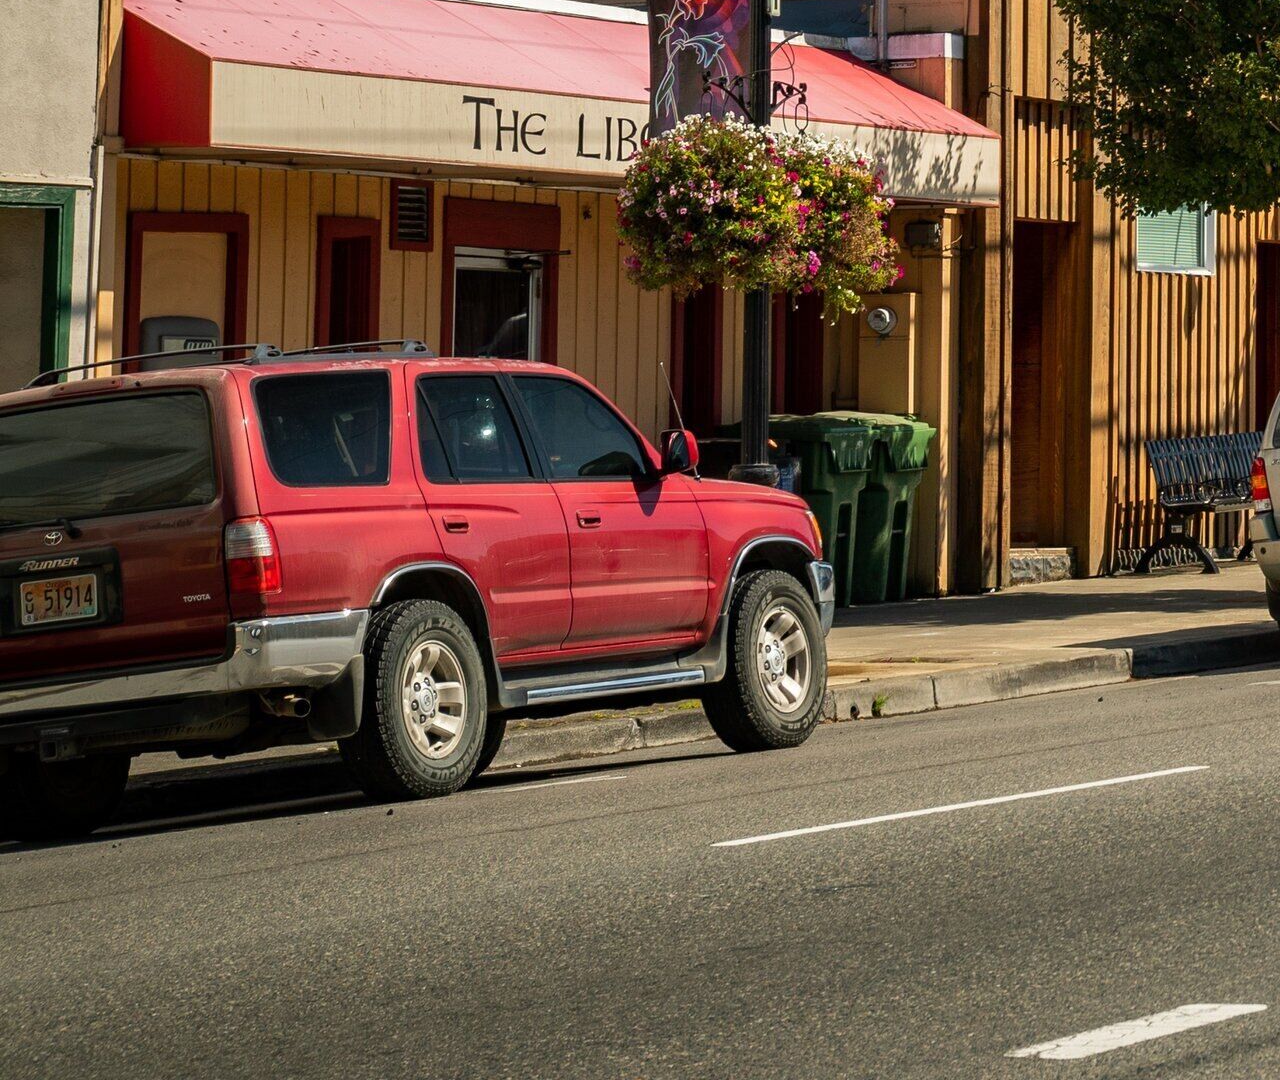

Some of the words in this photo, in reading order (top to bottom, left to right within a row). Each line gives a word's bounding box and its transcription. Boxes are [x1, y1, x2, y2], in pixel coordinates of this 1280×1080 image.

[462, 94, 548, 156] THE
[43, 583, 94, 612] 51914
[182, 593, 212, 604] TOYOTA
